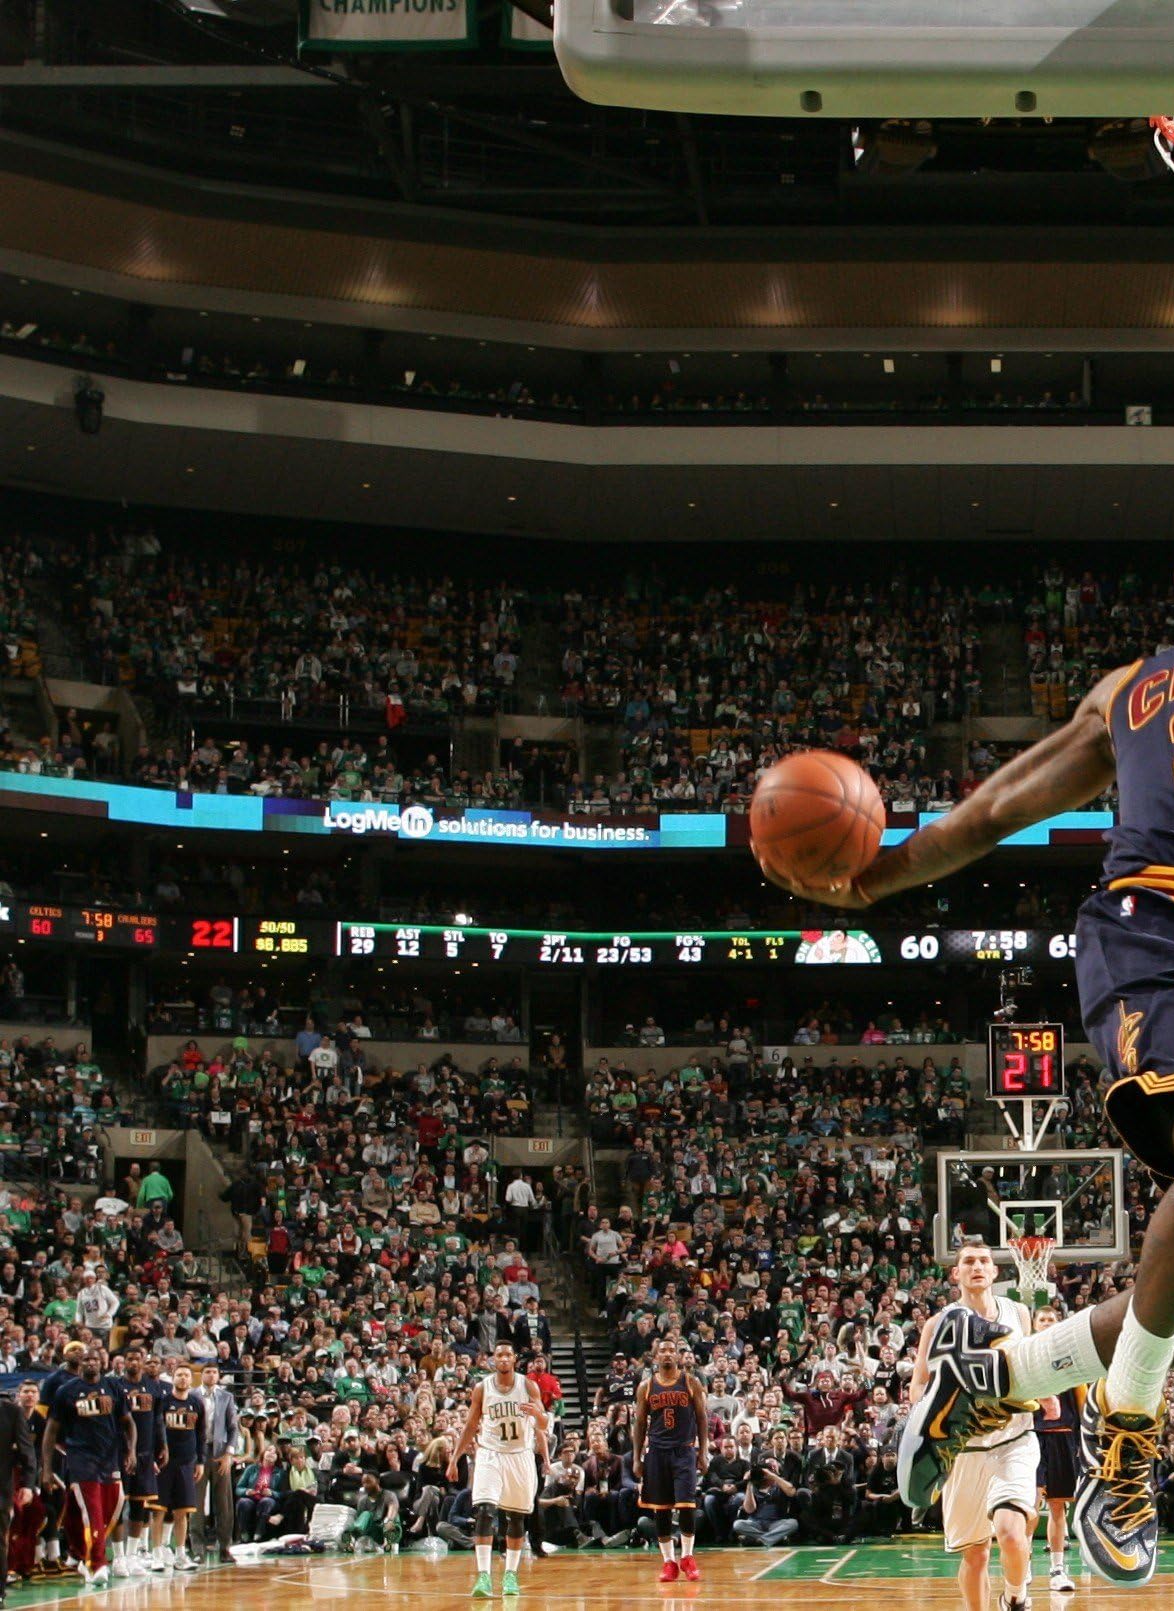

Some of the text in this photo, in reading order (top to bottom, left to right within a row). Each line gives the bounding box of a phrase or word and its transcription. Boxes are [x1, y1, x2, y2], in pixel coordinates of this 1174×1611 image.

[438, 818, 528, 837] solutions
[530, 819, 560, 839] for
[563, 822, 650, 842] business.
[31, 919, 51, 935] 60
[82, 911, 113, 928] 7:58
[192, 920, 231, 947] 22
[260, 921, 295, 934] 50/50
[350, 926, 375, 938] REB
[396, 928, 421, 940] AST
[134, 928, 155, 944] 65
[443, 930, 465, 942] STL
[489, 932, 508, 943] TO
[543, 935, 567, 946] 3PT
[613, 936, 631, 947] FG
[676, 936, 706, 947] FG%
[731, 937, 750, 946] TOL
[765, 937, 784, 946] FLS
[972, 931, 1027, 950] 7:58
[351, 938, 374, 954] 29
[397, 940, 419, 956] 12
[446, 942, 458, 957] 5
[491, 944, 503, 959] 7
[901, 936, 938, 959] 60
[540, 947, 584, 963] 2/11
[597, 947, 651, 964] 23/53
[678, 947, 702, 962] 43
[769, 949, 778, 959] 1
[977, 951, 1013, 961] QTR 3
[1012, 1032, 1054, 1051] 7:58
[1003, 1054, 1049, 1089] 21
[136, 1132, 152, 1143] EXIT
[533, 1141, 548, 1151] EXIT
[649, 1391, 689, 1409] CAVS
[664, 1409, 675, 1429] 5
[500, 1422, 518, 1440] 11
